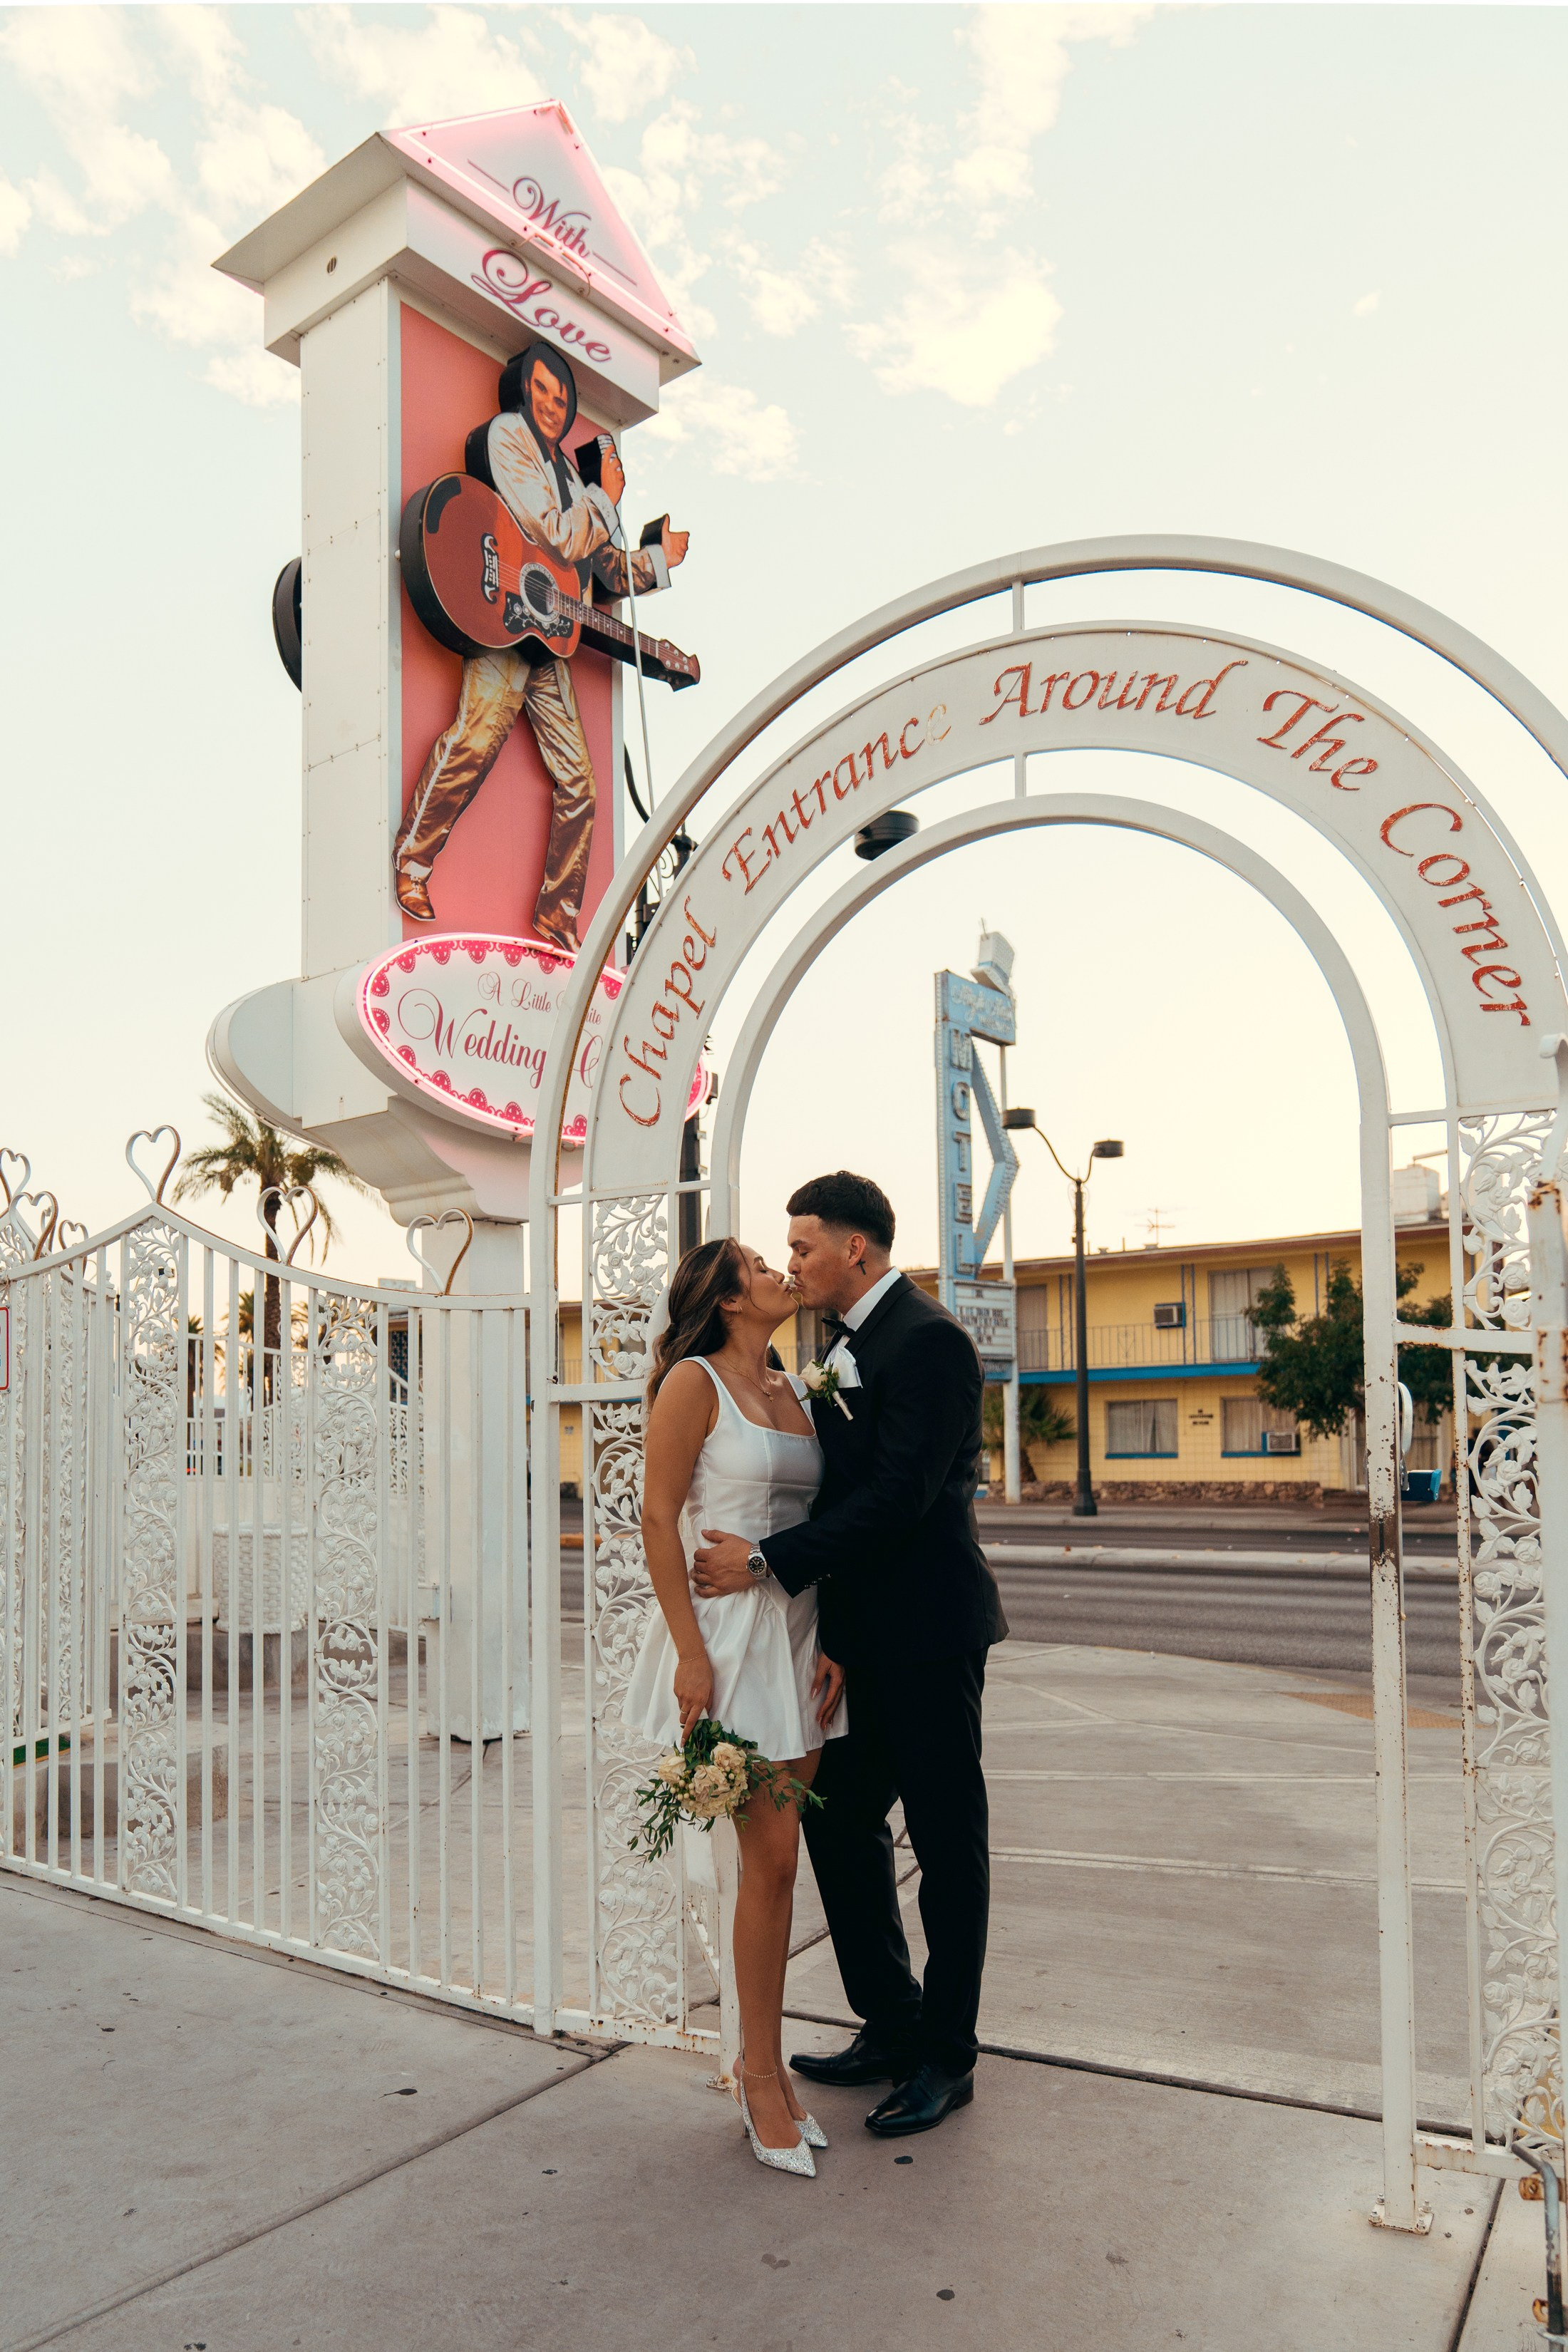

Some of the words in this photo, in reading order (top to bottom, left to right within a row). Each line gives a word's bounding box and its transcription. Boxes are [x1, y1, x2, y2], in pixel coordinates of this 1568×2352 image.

[512, 177, 592, 258] With
[470, 249, 612, 363] Love
[619, 894, 717, 1128] Chapel
[721, 703, 952, 896] Entrance
[979, 660, 1249, 726] Around
[1257, 689, 1379, 792] The
[1379, 803, 1532, 1028] Corner
[398, 988, 547, 1089] Wedding
[478, 971, 504, 1006] A
[511, 978, 552, 1013] Little
[951, 1028, 976, 1276] MOTEL
